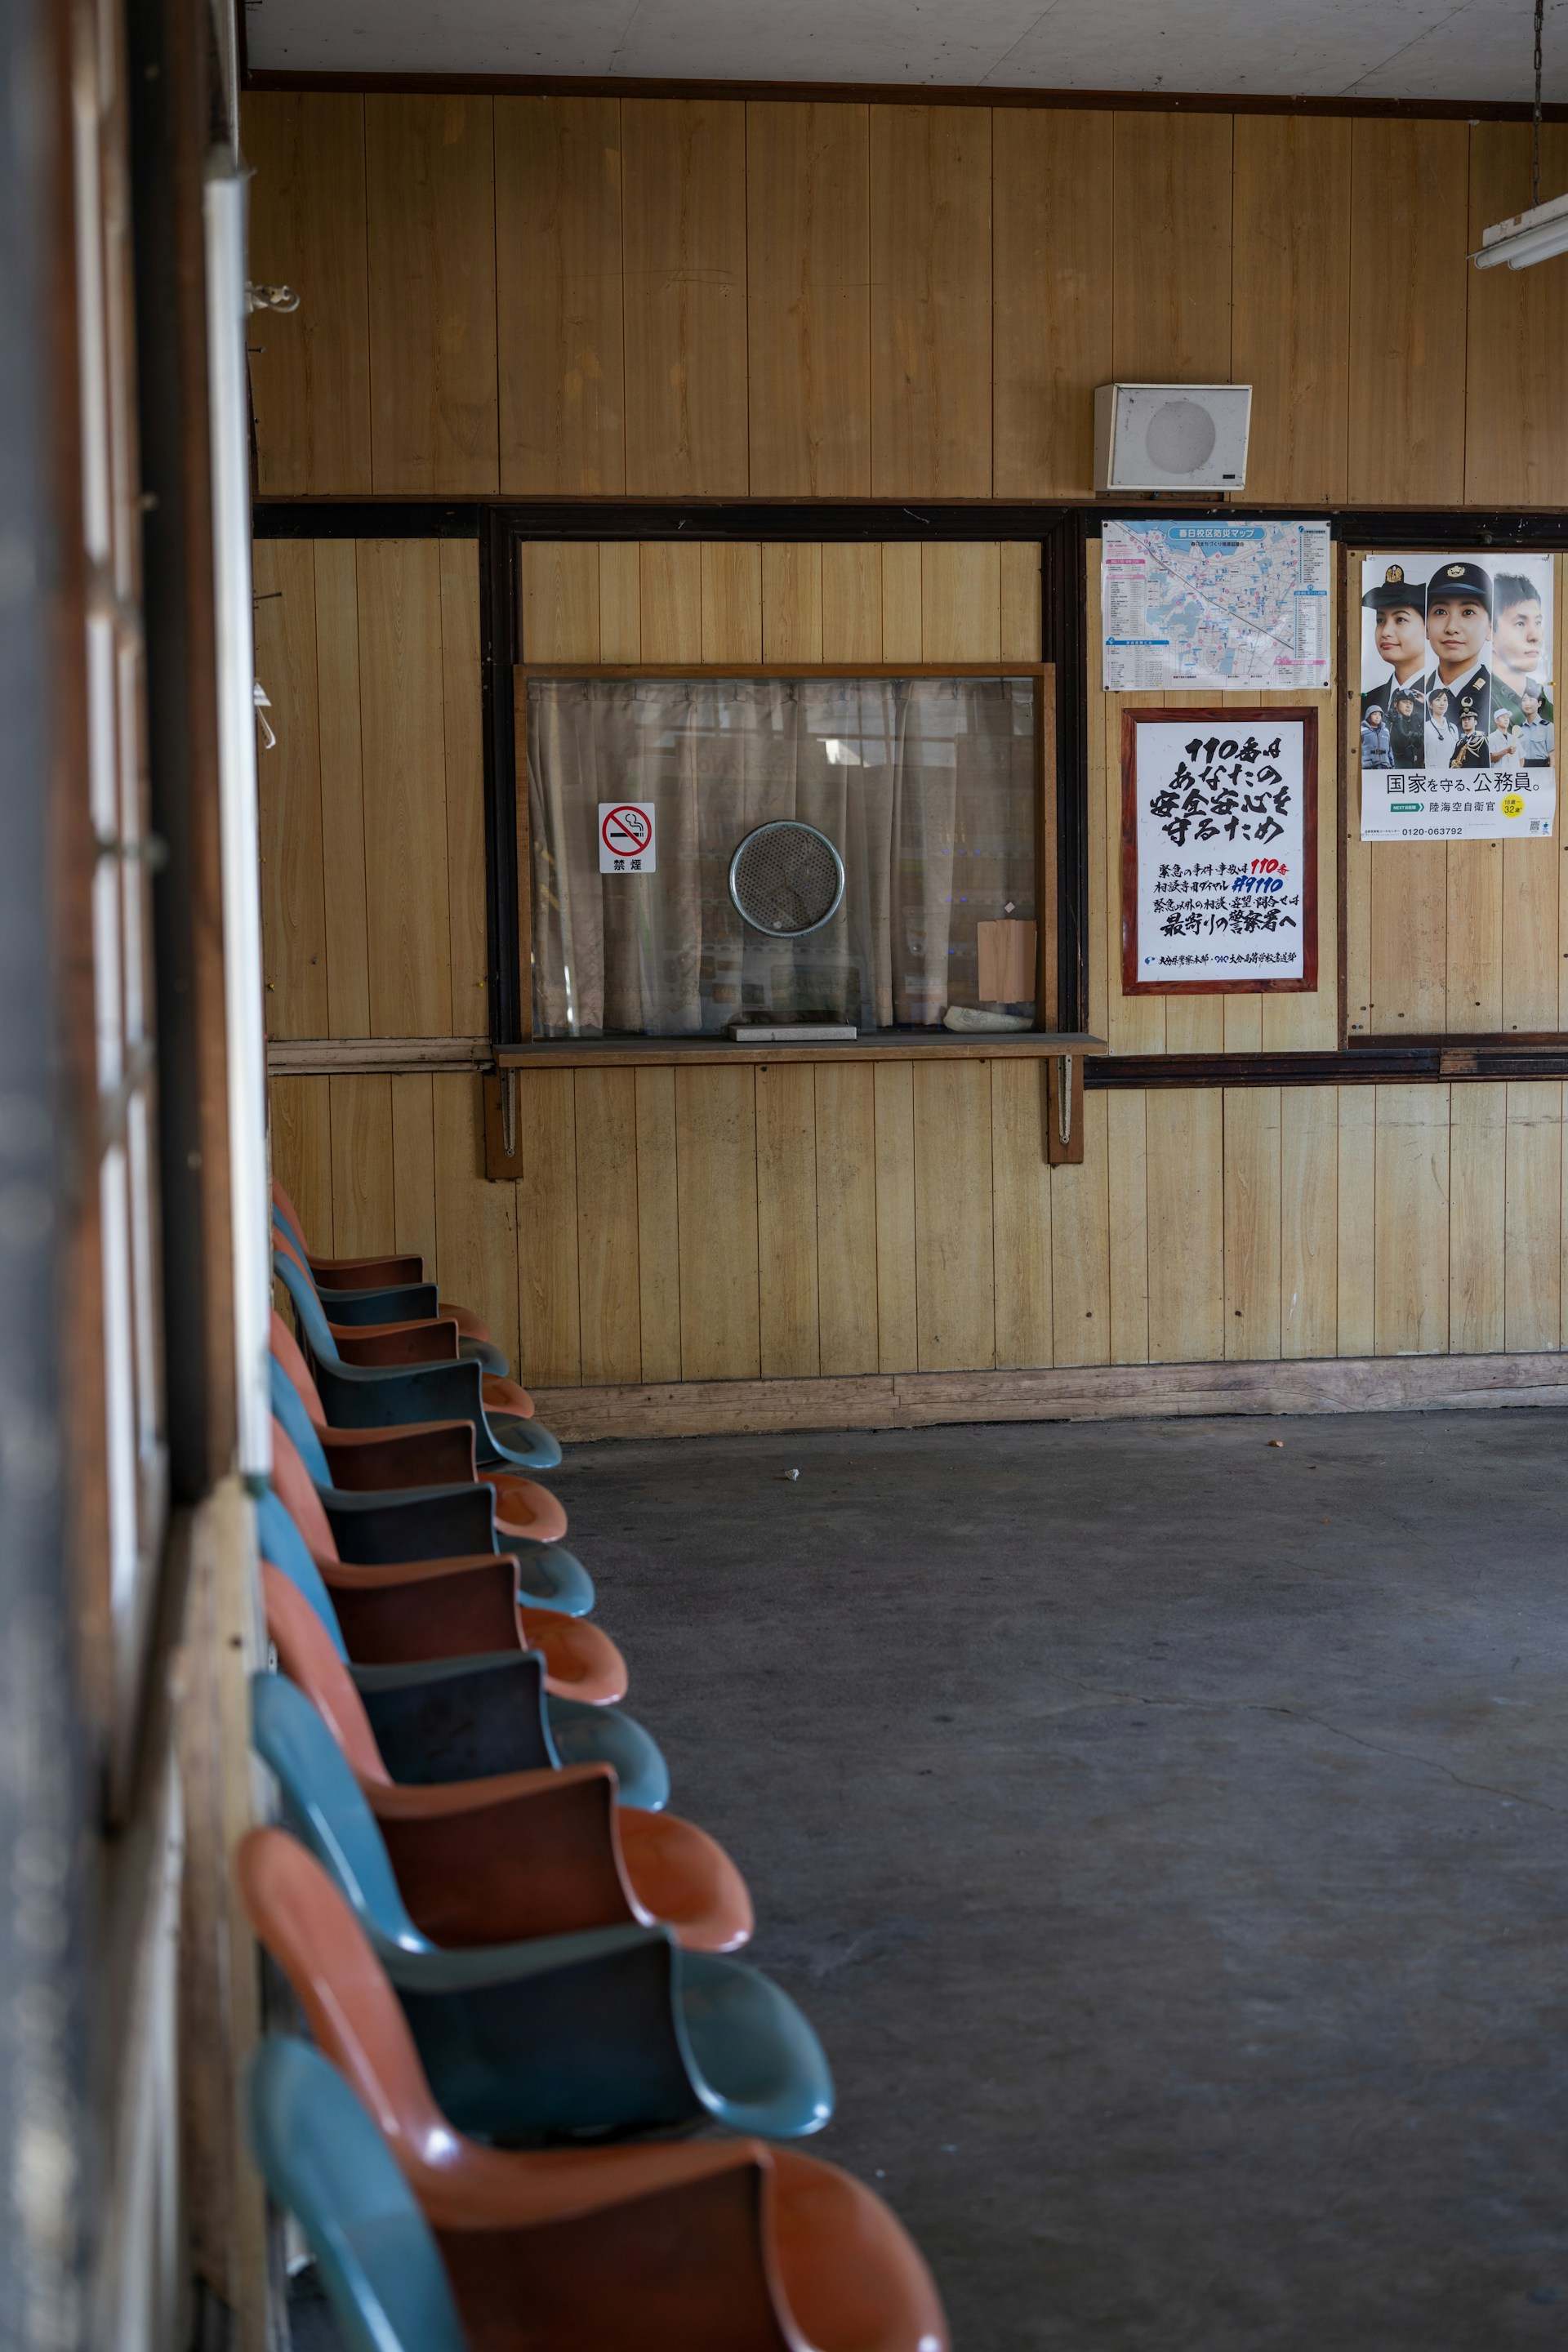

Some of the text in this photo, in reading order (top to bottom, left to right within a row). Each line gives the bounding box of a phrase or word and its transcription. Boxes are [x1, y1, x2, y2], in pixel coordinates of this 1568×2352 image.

[1179, 528, 1254, 538] 春日校区防災マップ
[1185, 737, 1281, 764] 110番は
[1169, 761, 1283, 791] あなたの
[1387, 772, 1539, 794] 国家を守る、公務員。
[1150, 786, 1291, 817] 安全安心を
[1429, 801, 1496, 813] 陸海空自衛官
[1162, 815, 1285, 847] 守るため
[1402, 827, 1463, 835] 0120-063792
[613, 859, 642, 871] 禁煙
[1160, 908, 1297, 937] 最寄りの警察署へ
